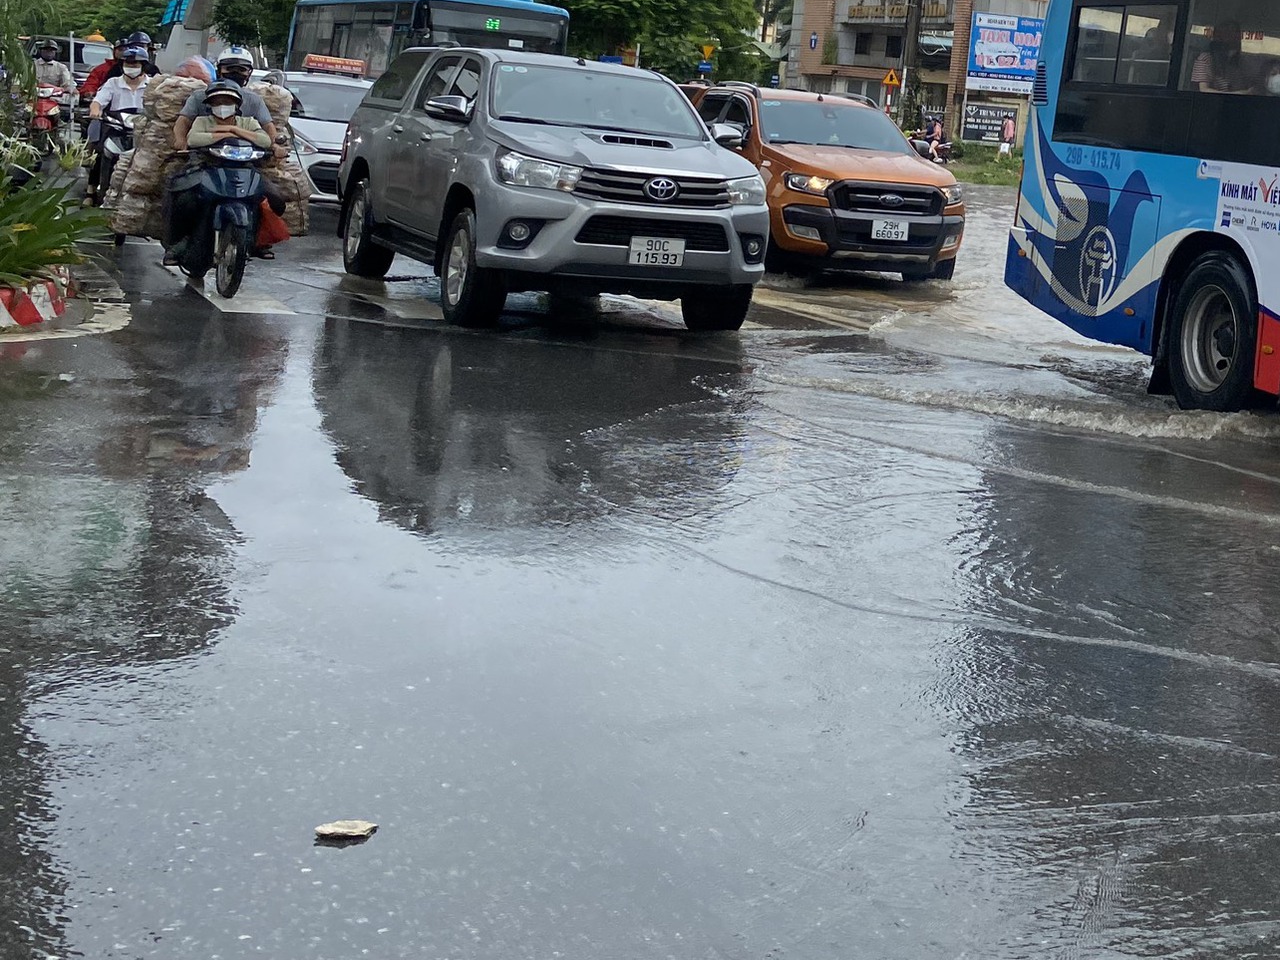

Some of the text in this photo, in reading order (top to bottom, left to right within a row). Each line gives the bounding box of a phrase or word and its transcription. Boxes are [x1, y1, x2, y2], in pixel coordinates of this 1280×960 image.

[979, 28, 1011, 44] TAXI
[1066, 146, 1083, 165] 29B
[1090, 149, 1121, 170] 415.74
[1221, 180, 1240, 199] KÍNH
[1241, 181, 1258, 201] MẮT
[1261, 221, 1277, 231] HOYA
[875, 230, 904, 239] 660.97
[646, 240, 670, 251] 90C
[637, 252, 678, 265] 115.93
